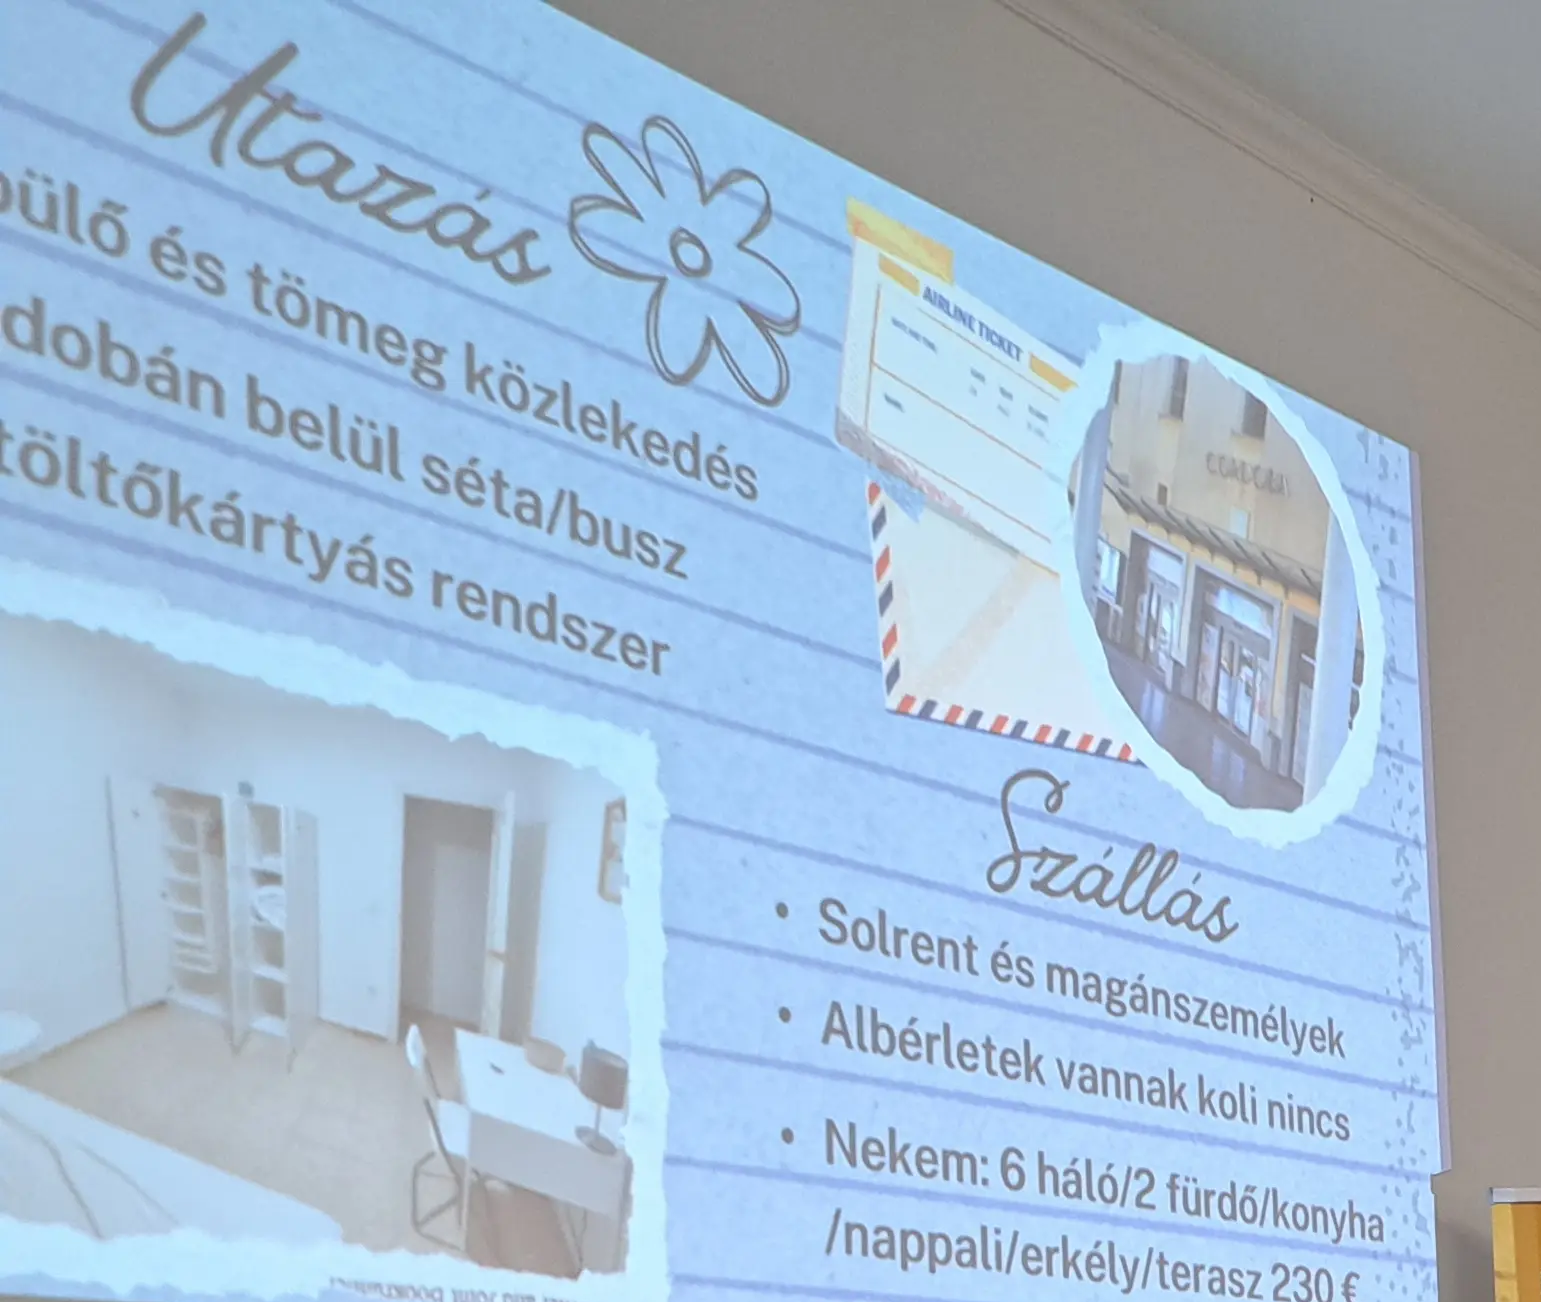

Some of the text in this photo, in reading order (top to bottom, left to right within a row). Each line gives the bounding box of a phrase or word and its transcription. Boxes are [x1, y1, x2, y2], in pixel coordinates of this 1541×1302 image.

[130, 11, 552, 284] Utazás
[149, 224, 227, 297] és
[247, 262, 448, 392] tömeg
[465, 342, 759, 502] közlekedés
[978, 319, 1024, 362] TICKET
[2, 296, 688, 580] dobán belül séta/busz
[432, 566, 671, 677] rendszer
[986, 768, 1240, 943] Szállás
[818, 897, 1346, 1060] Solrent és magánszemélyek
[821, 1000, 1351, 1142] Albérletek vannak koli nincs
[824, 1118, 1385, 1243] Nekem: 6 háló/2 fürdő/konyha
[824, 1208, 1262, 1299] /nappali/erkély/terasz
